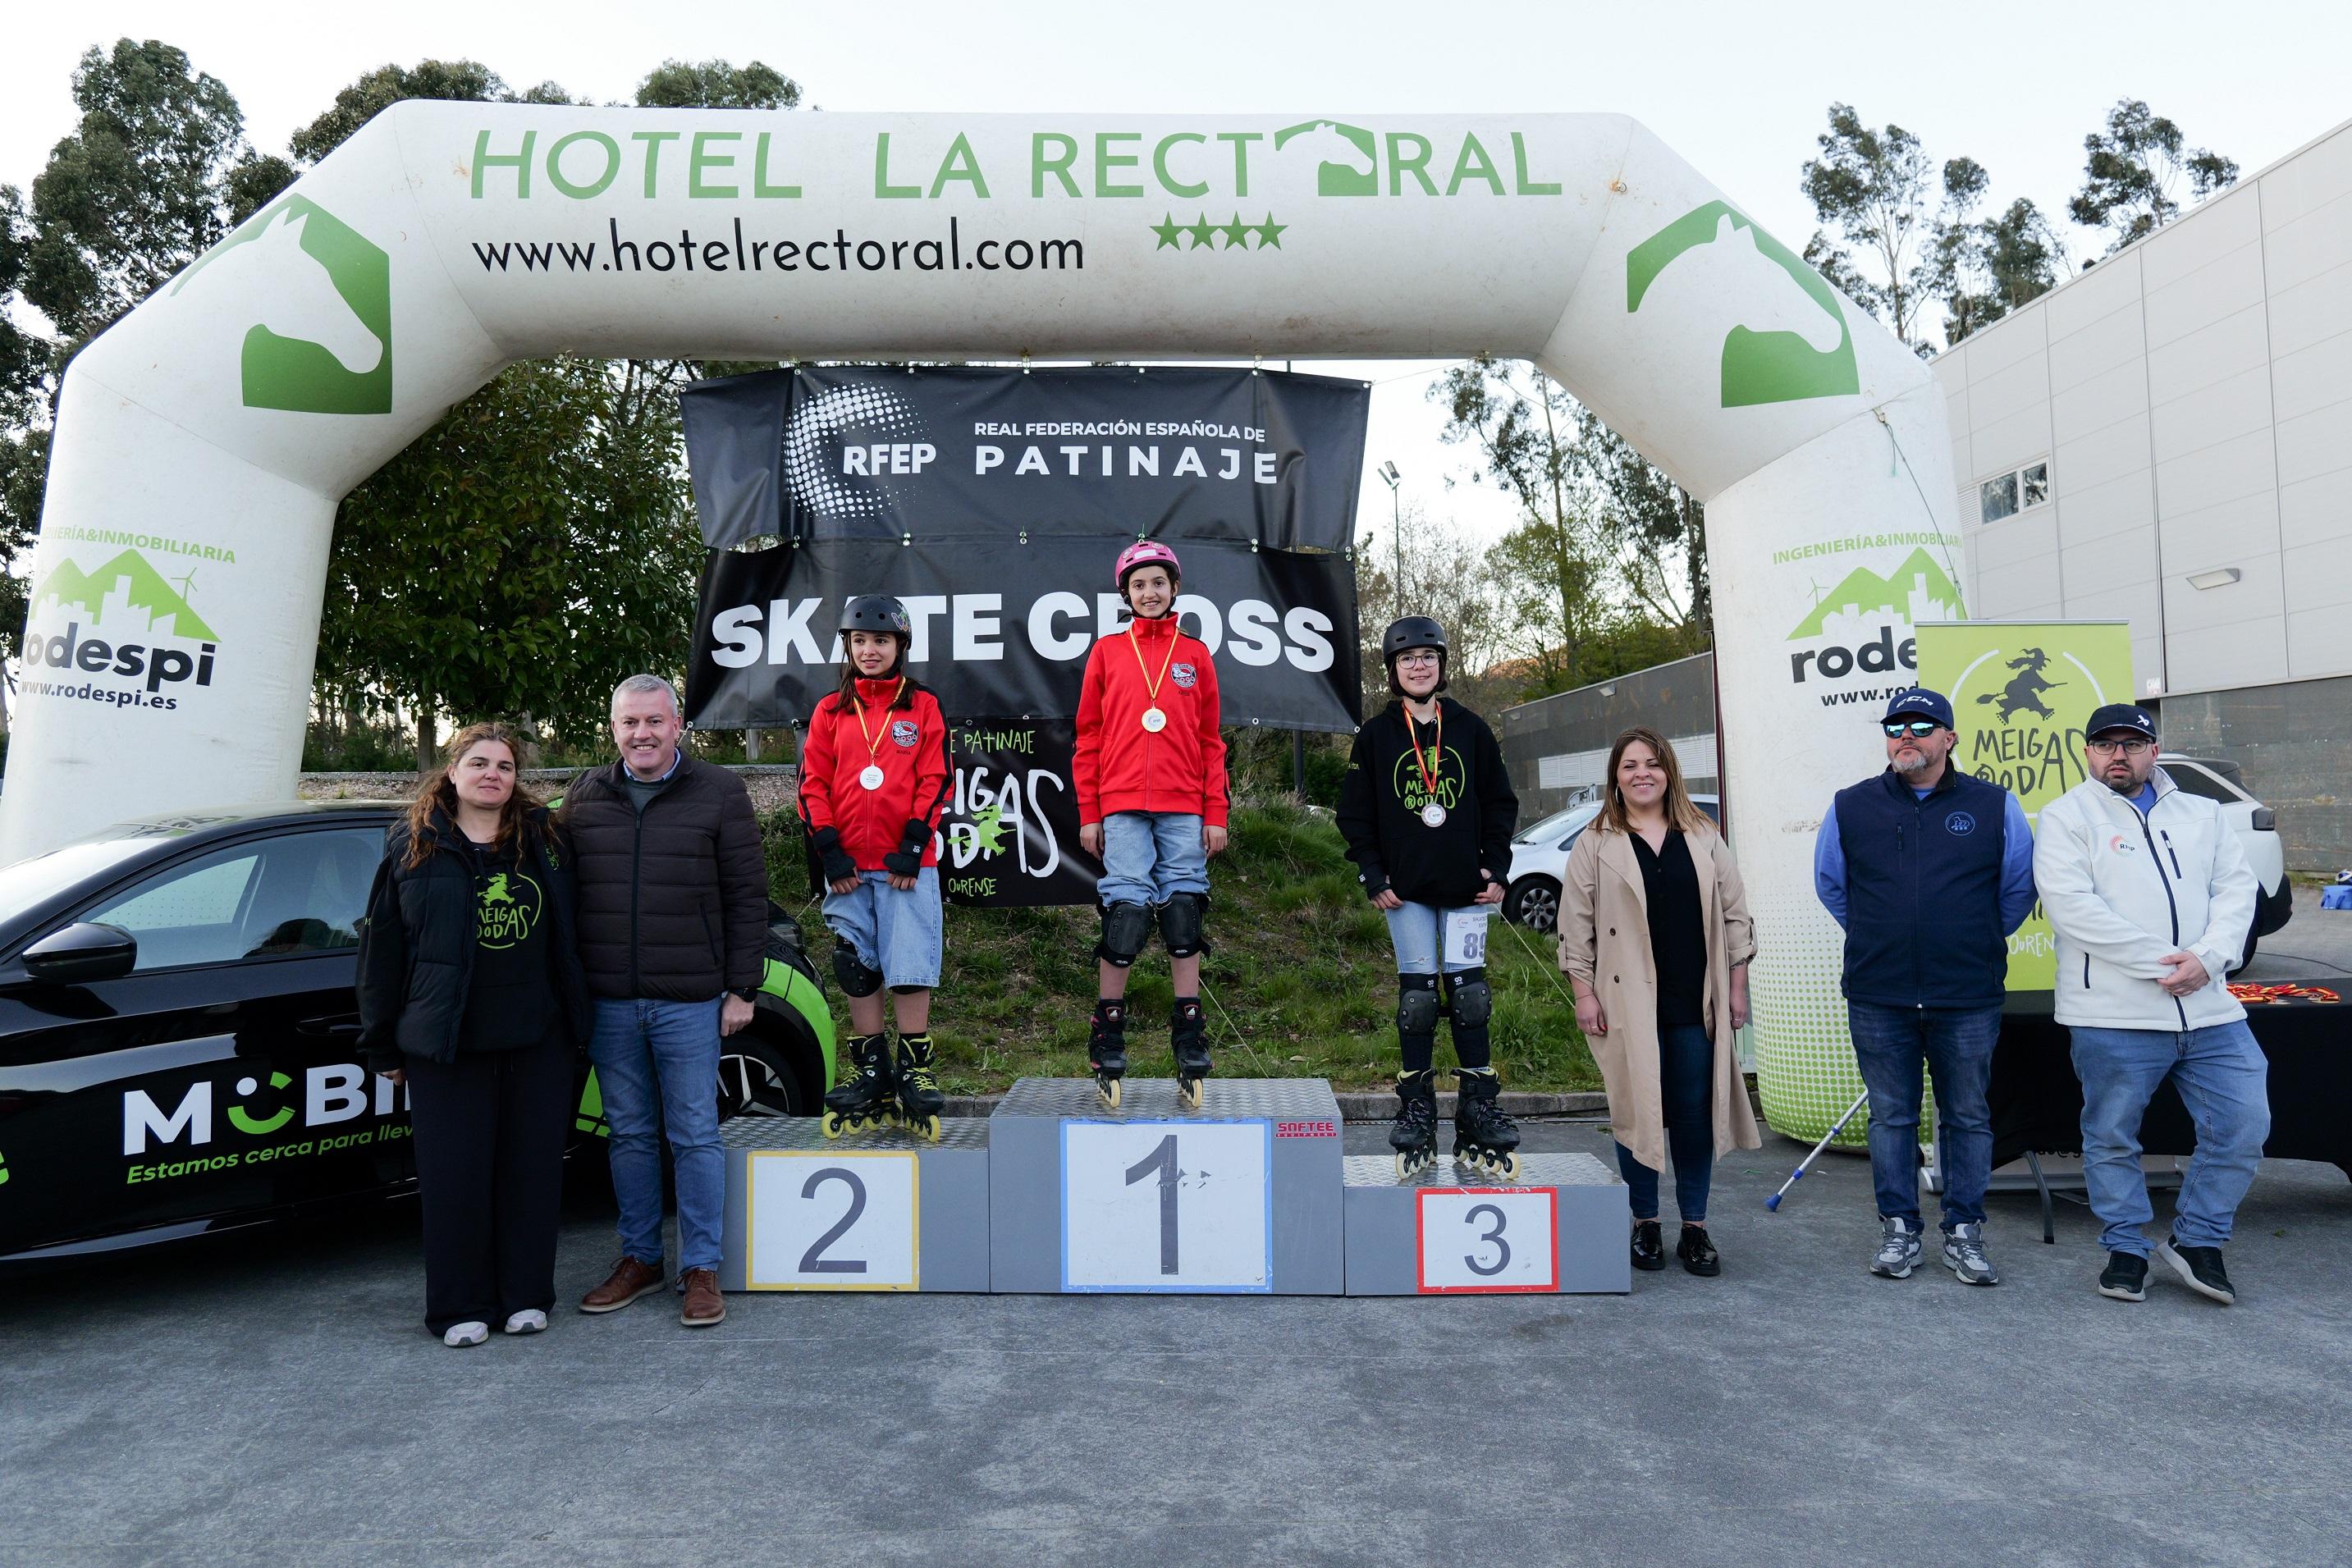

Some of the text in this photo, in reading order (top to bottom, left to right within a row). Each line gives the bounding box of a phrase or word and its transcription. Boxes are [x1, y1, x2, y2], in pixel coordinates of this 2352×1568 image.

[470, 130, 803, 199] HOTEL
[875, 130, 991, 199] LA
[471, 217, 1083, 272] www.hotelrectoral.com
[843, 443, 937, 475] RFEP
[974, 418, 1265, 443] REAL FEDERACIÓN ESPAÑOLA DE
[975, 446, 1278, 484] PATINAJE
[711, 594, 1004, 669] SKTE
[1791, 625, 1918, 683] rode
[21, 683, 177, 711] www.rodespi.es
[964, 729, 1036, 754] PATINAJE
[126, 1124, 413, 1184] Estamos cerca para llev
[798, 1167, 867, 1273] 2
[1125, 1134, 1179, 1275] 1
[1464, 1204, 1511, 1276] 3
